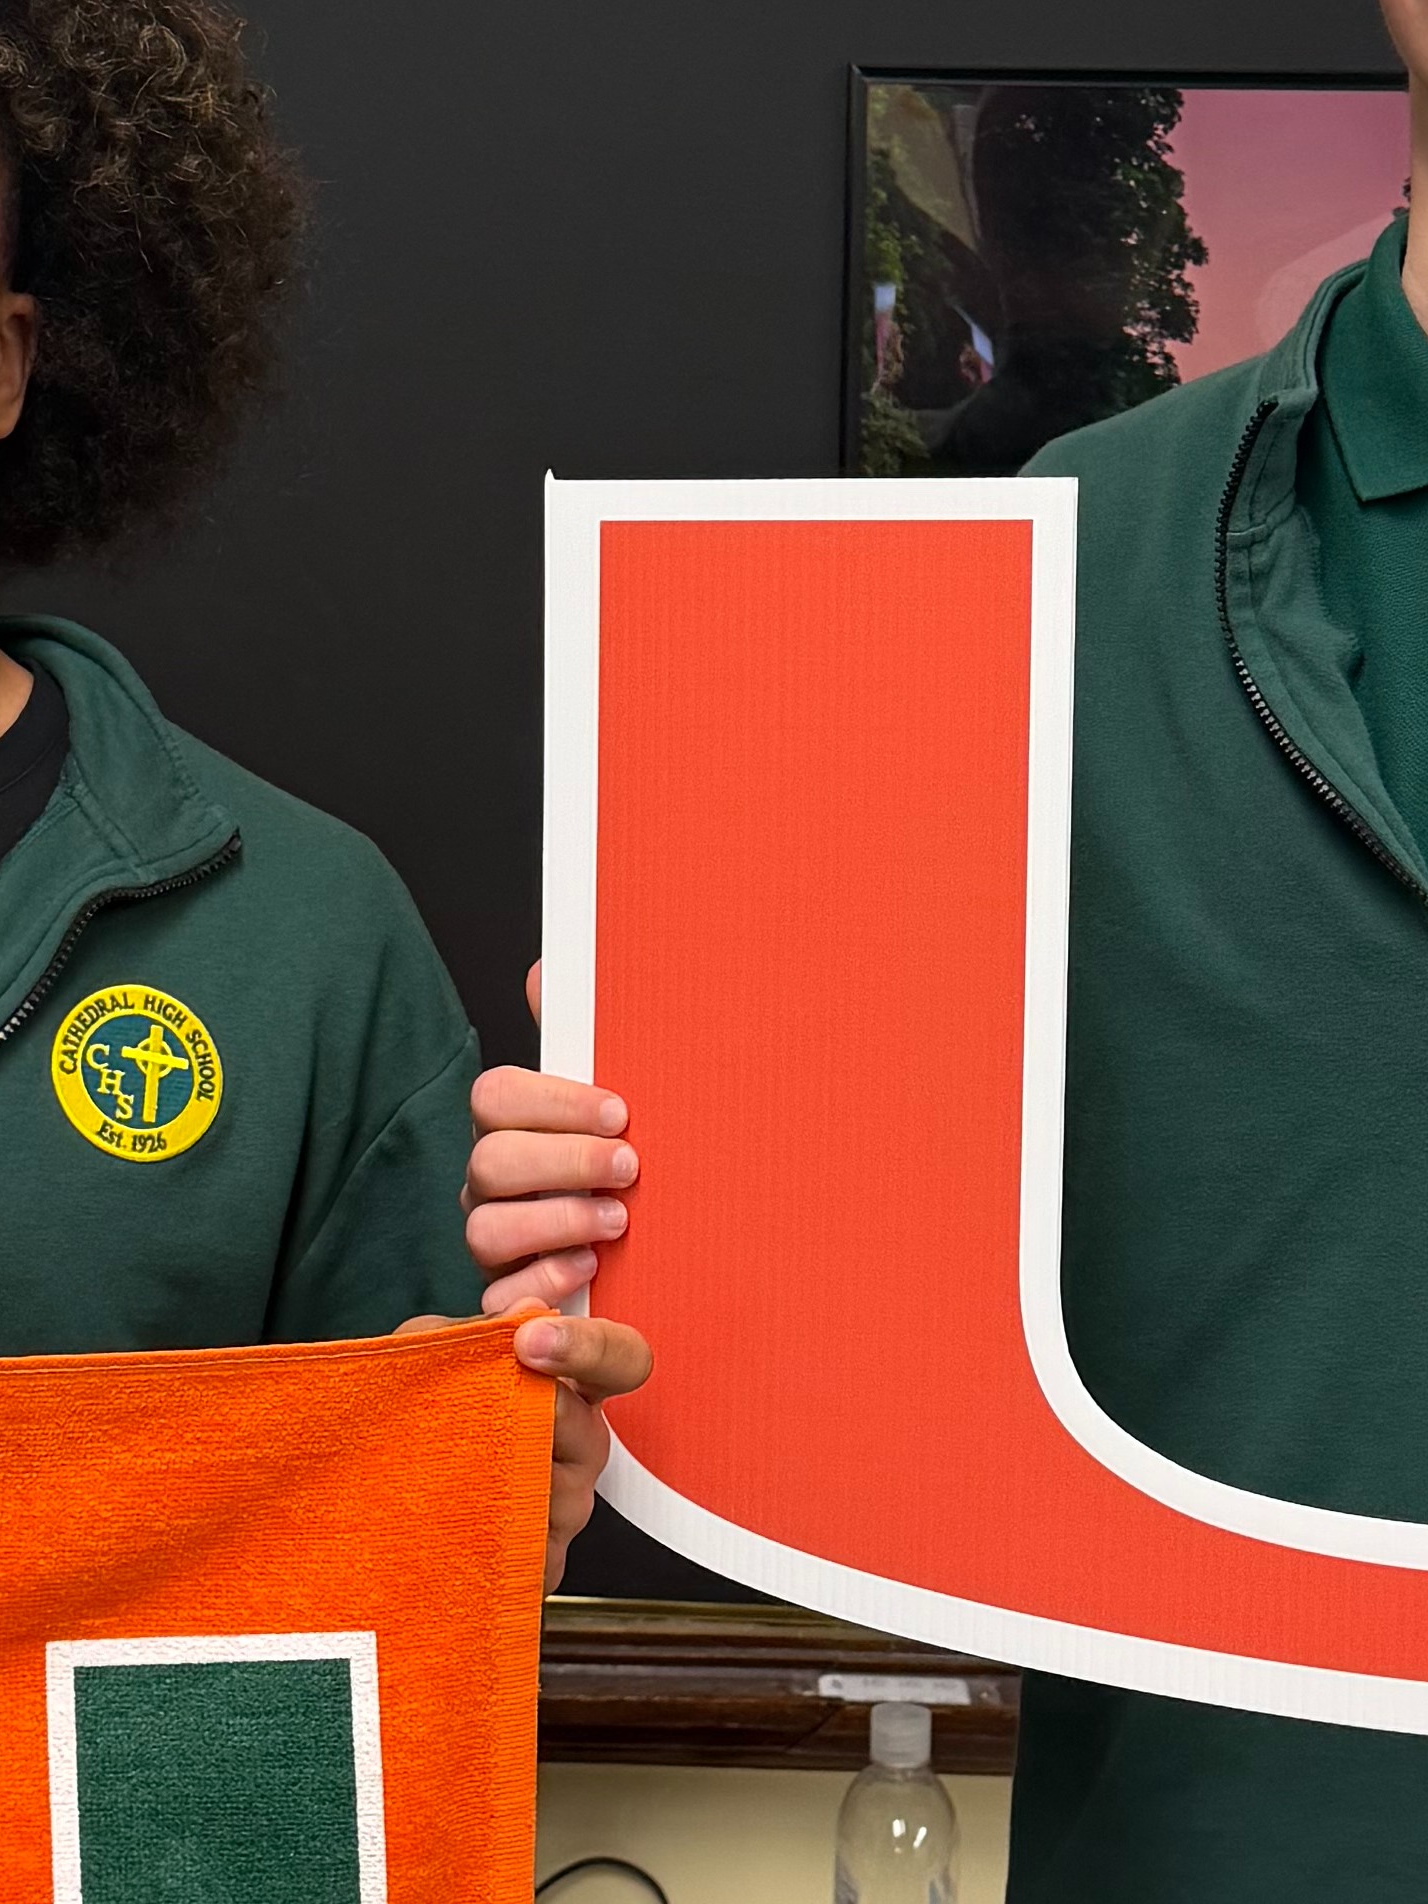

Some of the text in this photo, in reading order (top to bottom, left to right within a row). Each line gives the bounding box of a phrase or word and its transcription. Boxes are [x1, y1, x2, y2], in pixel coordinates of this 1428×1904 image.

[59, 992, 217, 1102] CATHEDRAL HIGH SCHOOL
[131, 1131, 167, 1154] 1926
